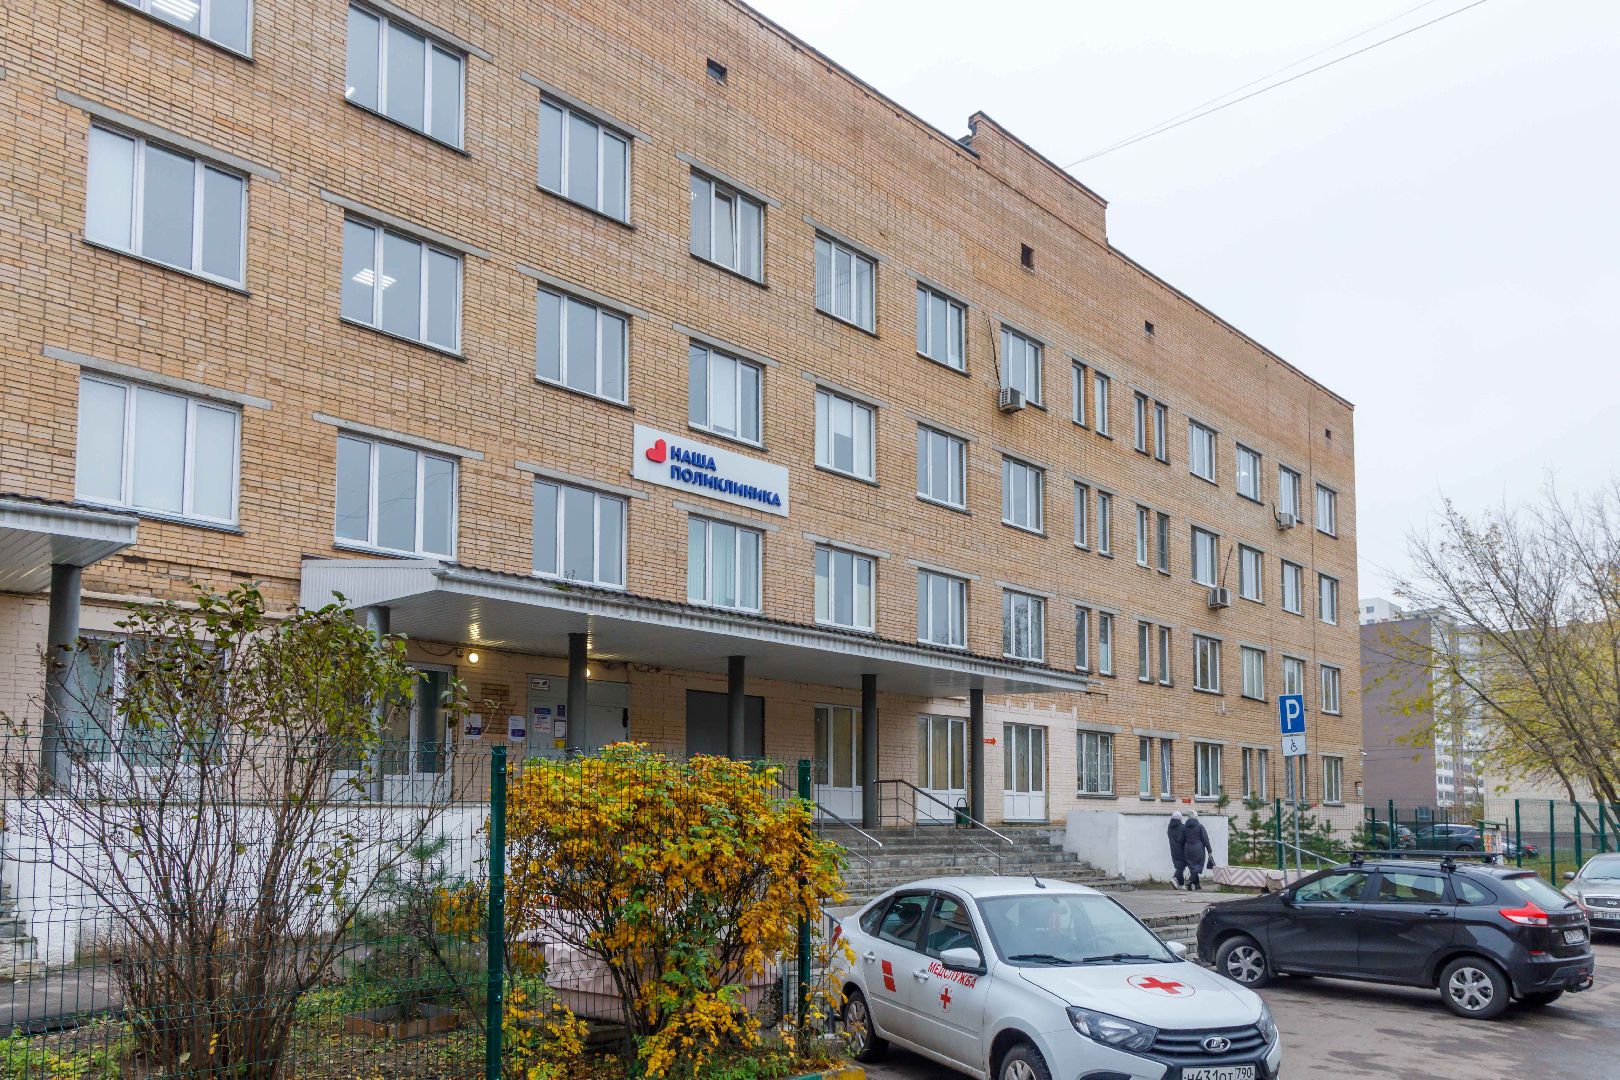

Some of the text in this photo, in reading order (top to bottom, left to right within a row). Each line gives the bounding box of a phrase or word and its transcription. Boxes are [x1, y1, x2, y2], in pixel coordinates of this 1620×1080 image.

[670, 445, 717, 471] НАША
[670, 464, 781, 506] ПОЛИКЛИНИКА
[1285, 699, 1300, 730] P
[928, 961, 977, 989] МЕДСЛУЖБА
